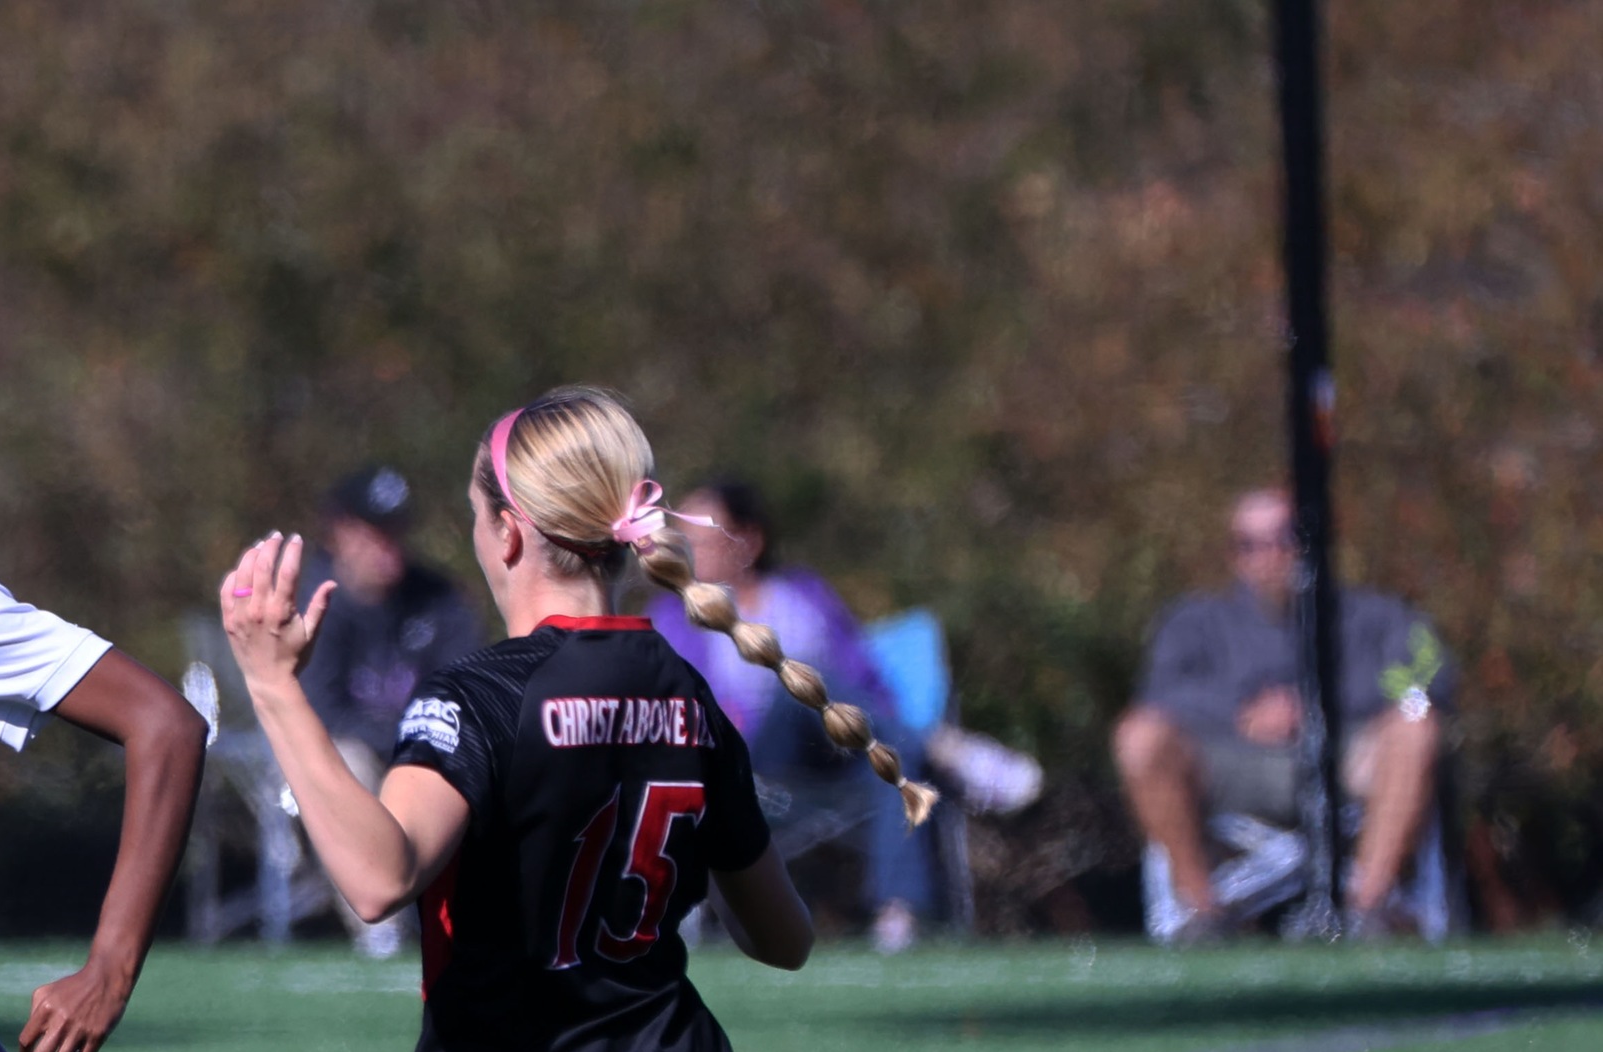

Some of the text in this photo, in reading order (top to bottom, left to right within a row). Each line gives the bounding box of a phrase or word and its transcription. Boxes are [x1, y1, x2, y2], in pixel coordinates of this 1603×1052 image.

[541, 697, 620, 748] CHRIST
[616, 697, 689, 746] ABOVE
[547, 780, 706, 971] 15
